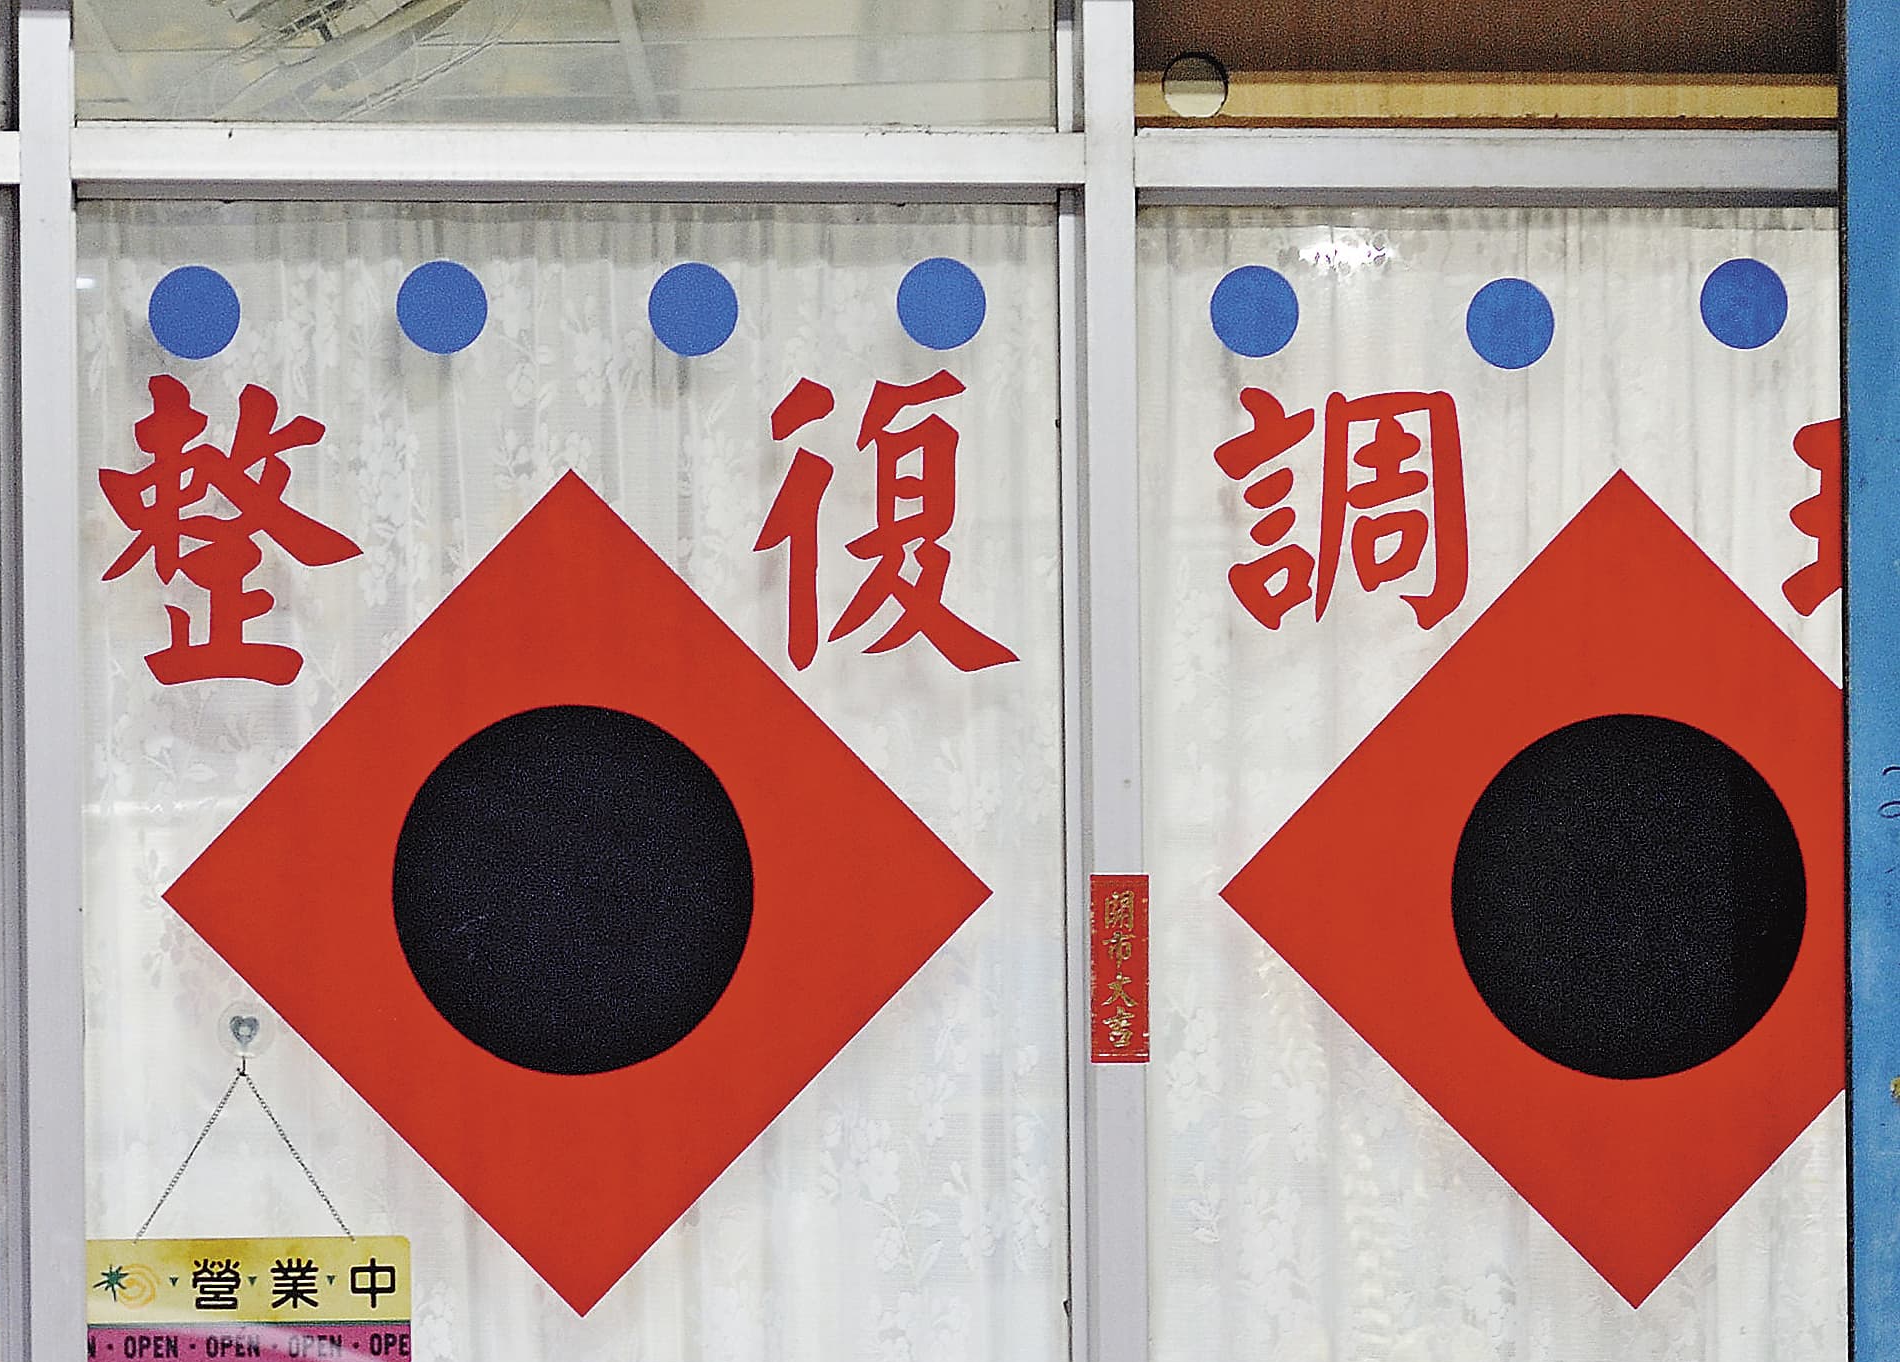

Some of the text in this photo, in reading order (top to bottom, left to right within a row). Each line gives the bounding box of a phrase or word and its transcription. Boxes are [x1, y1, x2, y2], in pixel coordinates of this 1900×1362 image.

[1101, 890, 1138, 1048] 開市大吉
[191, 1257, 396, 1311] 營業中
[123, 1335, 179, 1359] OPEN
[205, 1334, 261, 1358] OPEN
[288, 1334, 343, 1357] OPEN
